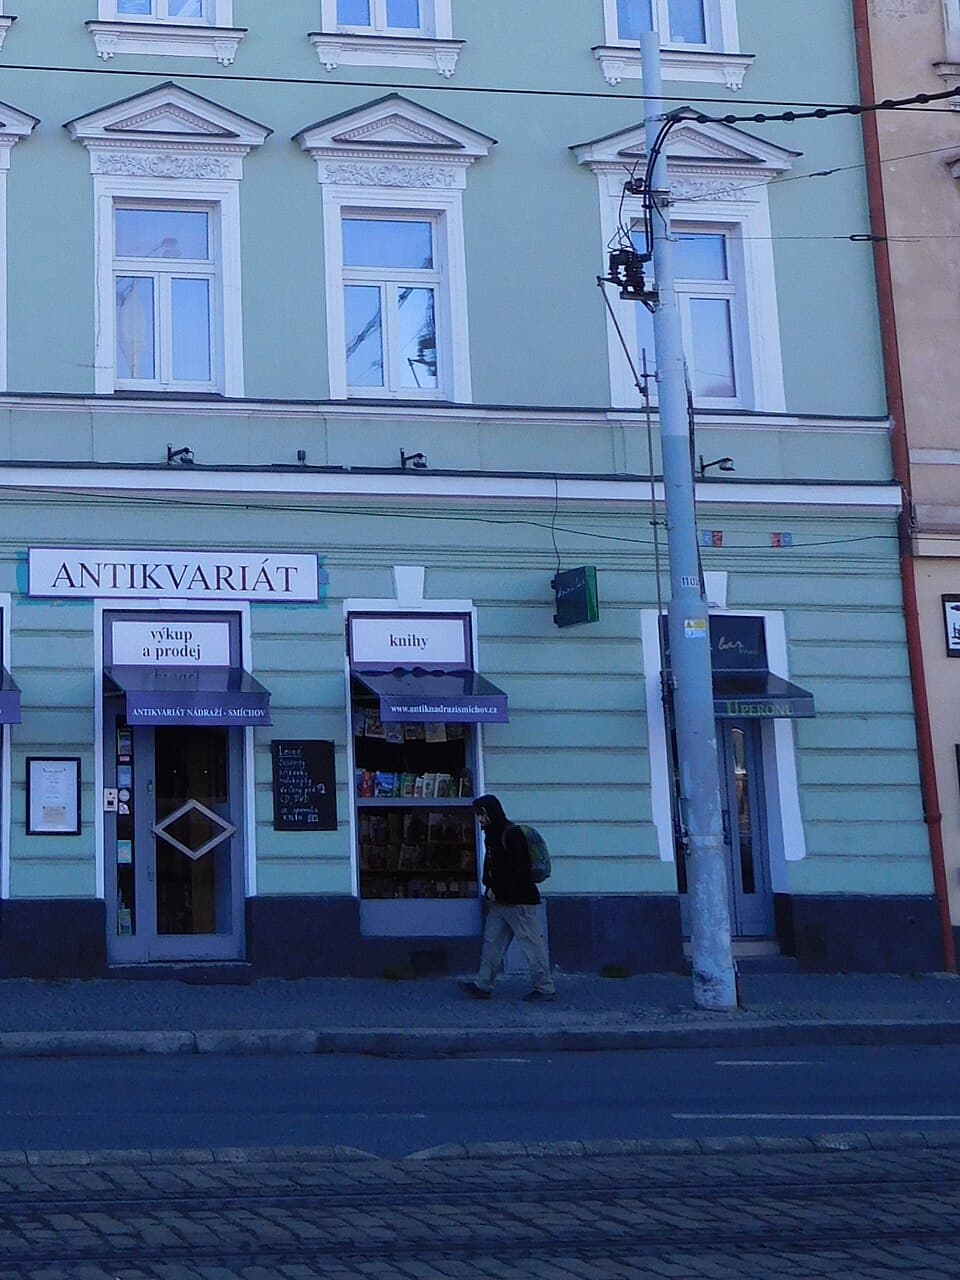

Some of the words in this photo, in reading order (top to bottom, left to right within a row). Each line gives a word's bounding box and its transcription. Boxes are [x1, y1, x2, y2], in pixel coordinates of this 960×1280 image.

[51, 558, 298, 593] ANTIKVARIÁT
[150, 627, 193, 643] výkup
[390, 634, 429, 650] knihy
[142, 647, 151, 657] a
[155, 645, 202, 660] prodej
[132, 707, 184, 717] ANTIKVARIÁT
[187, 707, 222, 717] NÁDRAŽÍ
[228, 707, 266, 717] SMÍCHOV
[390, 703, 497, 714] www.antiknadrazismichov.cz
